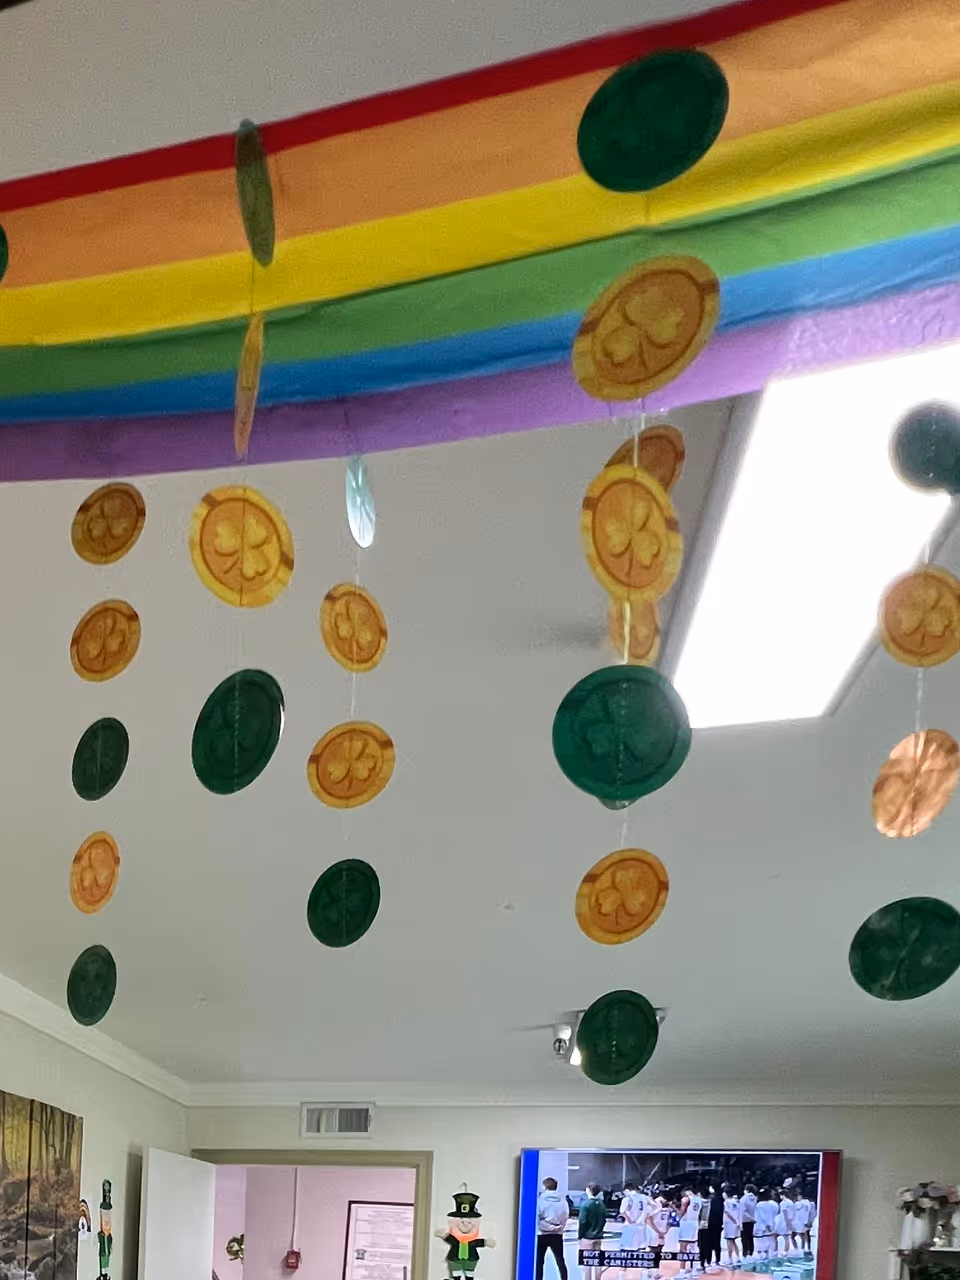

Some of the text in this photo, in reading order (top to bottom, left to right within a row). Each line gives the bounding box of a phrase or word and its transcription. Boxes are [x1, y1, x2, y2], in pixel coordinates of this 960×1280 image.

[582, 1250, 701, 1261] NOT PERMITTED TO HAVE
[582, 1258, 655, 1268] THE CANISTERS
